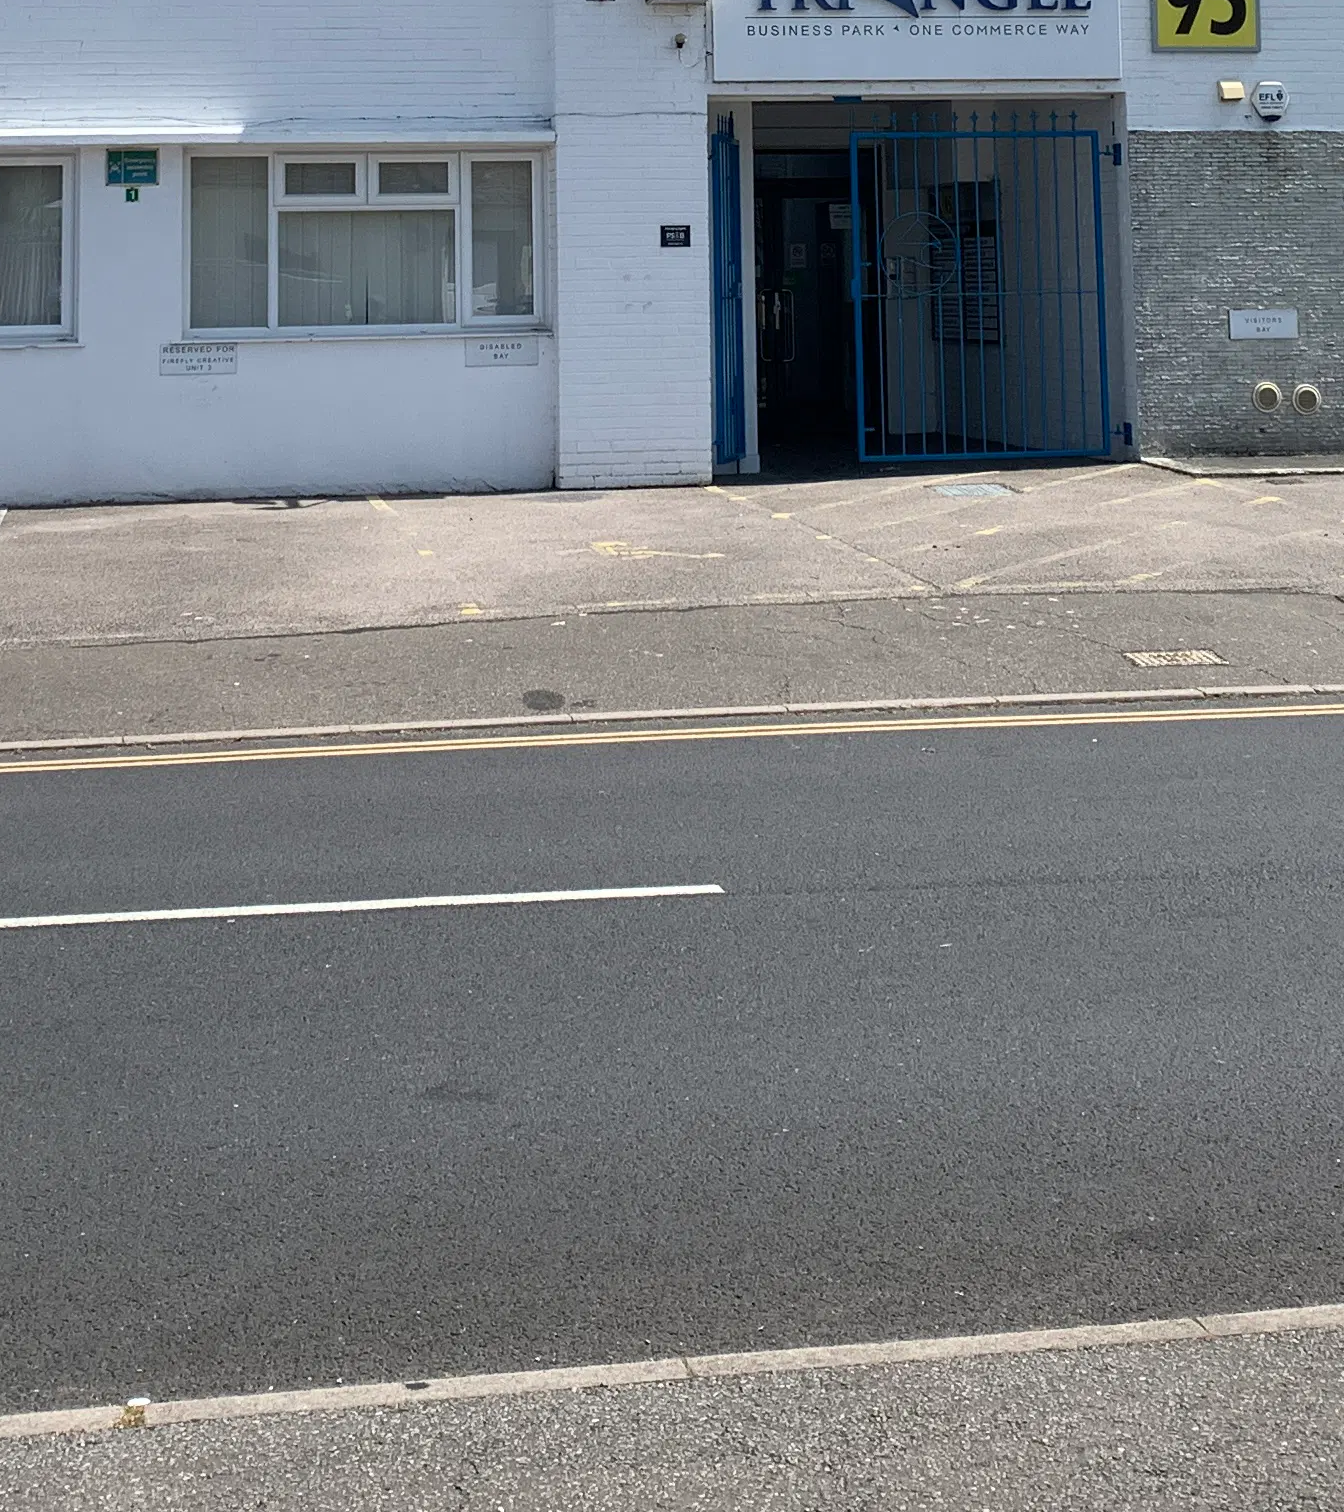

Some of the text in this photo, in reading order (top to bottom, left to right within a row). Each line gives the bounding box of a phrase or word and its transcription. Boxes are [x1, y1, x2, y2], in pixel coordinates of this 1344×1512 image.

[747, 24, 1090, 36] BUSINESS PARK ONE COMMERCE WAY
[1258, 92, 1275, 101] EFL
[129, 190, 135, 200] 1
[162, 345, 235, 354] RESERVED FOR
